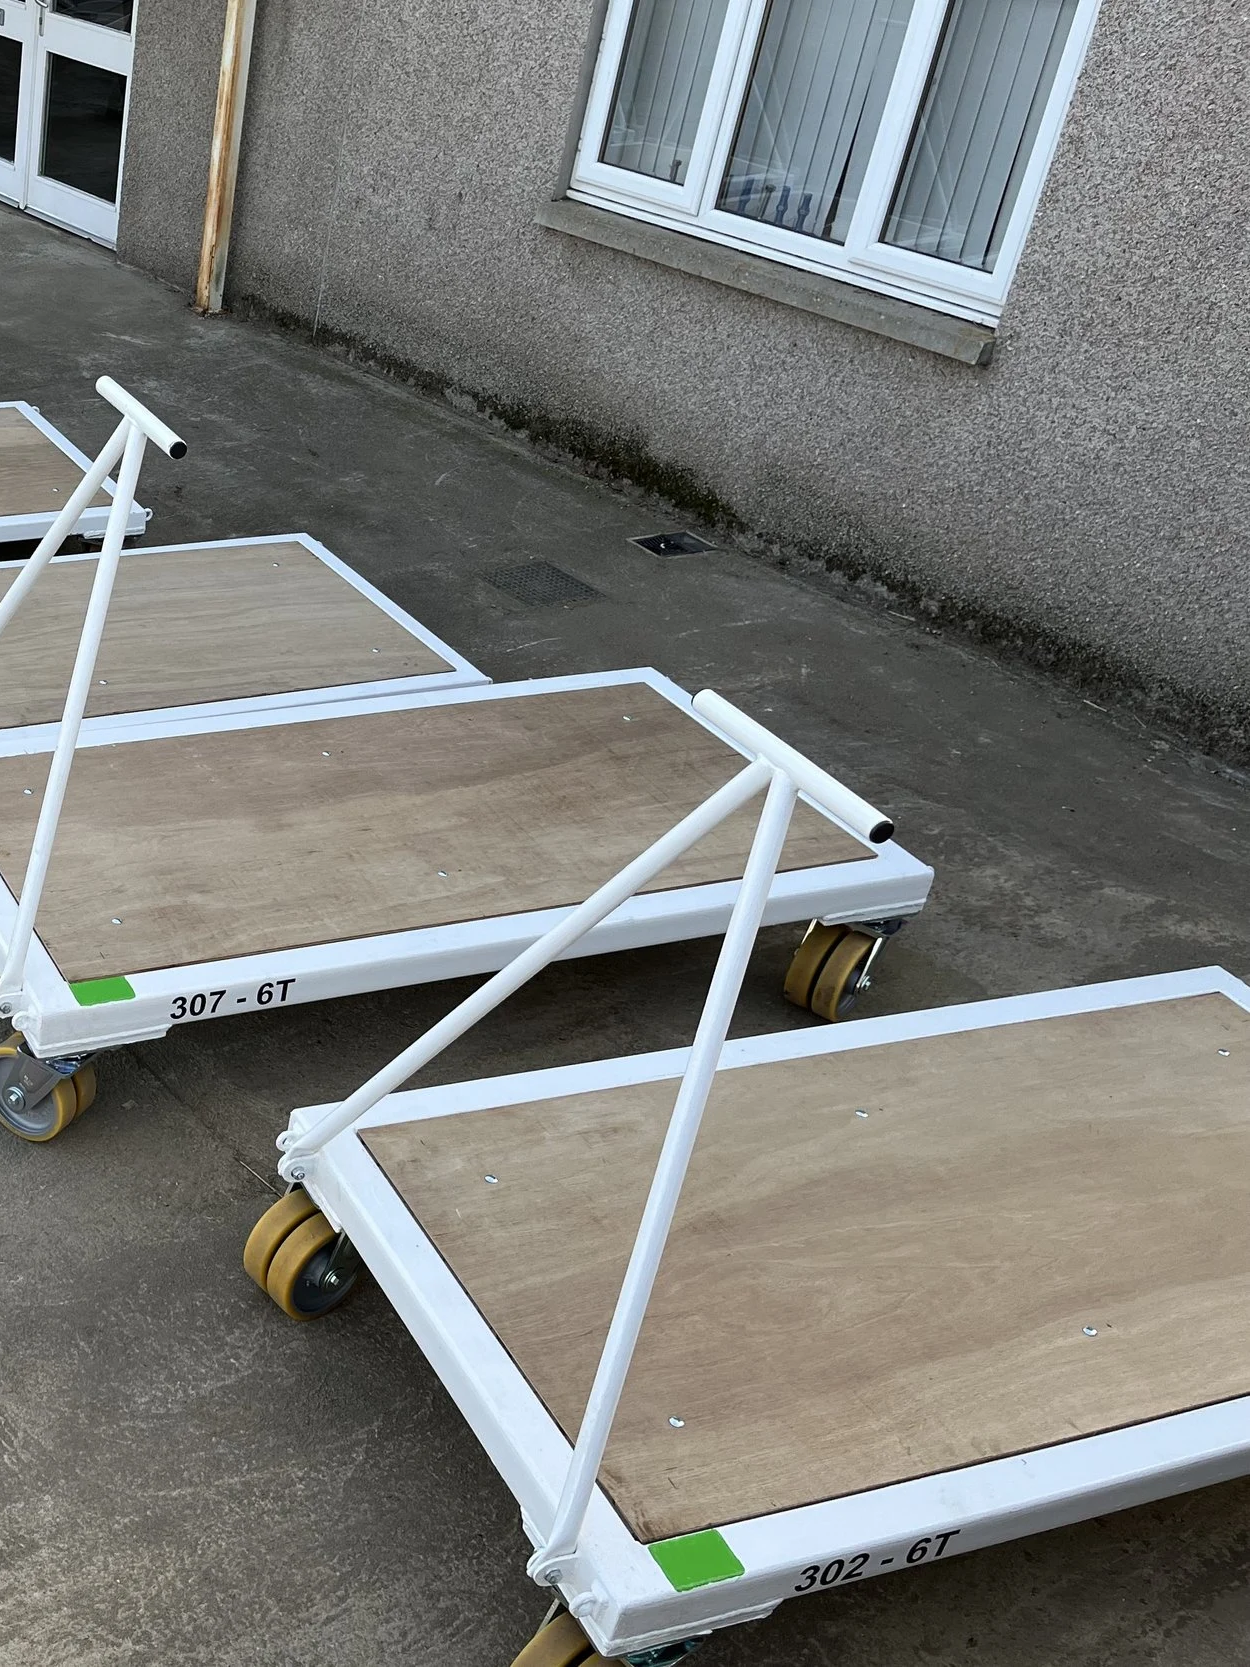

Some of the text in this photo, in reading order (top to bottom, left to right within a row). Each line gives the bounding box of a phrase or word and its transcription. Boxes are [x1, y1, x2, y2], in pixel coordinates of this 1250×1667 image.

[170, 989, 227, 1020] 307
[256, 977, 297, 1006] 6T
[794, 1552, 871, 1592] 302
[905, 1529, 962, 1564] 6T
